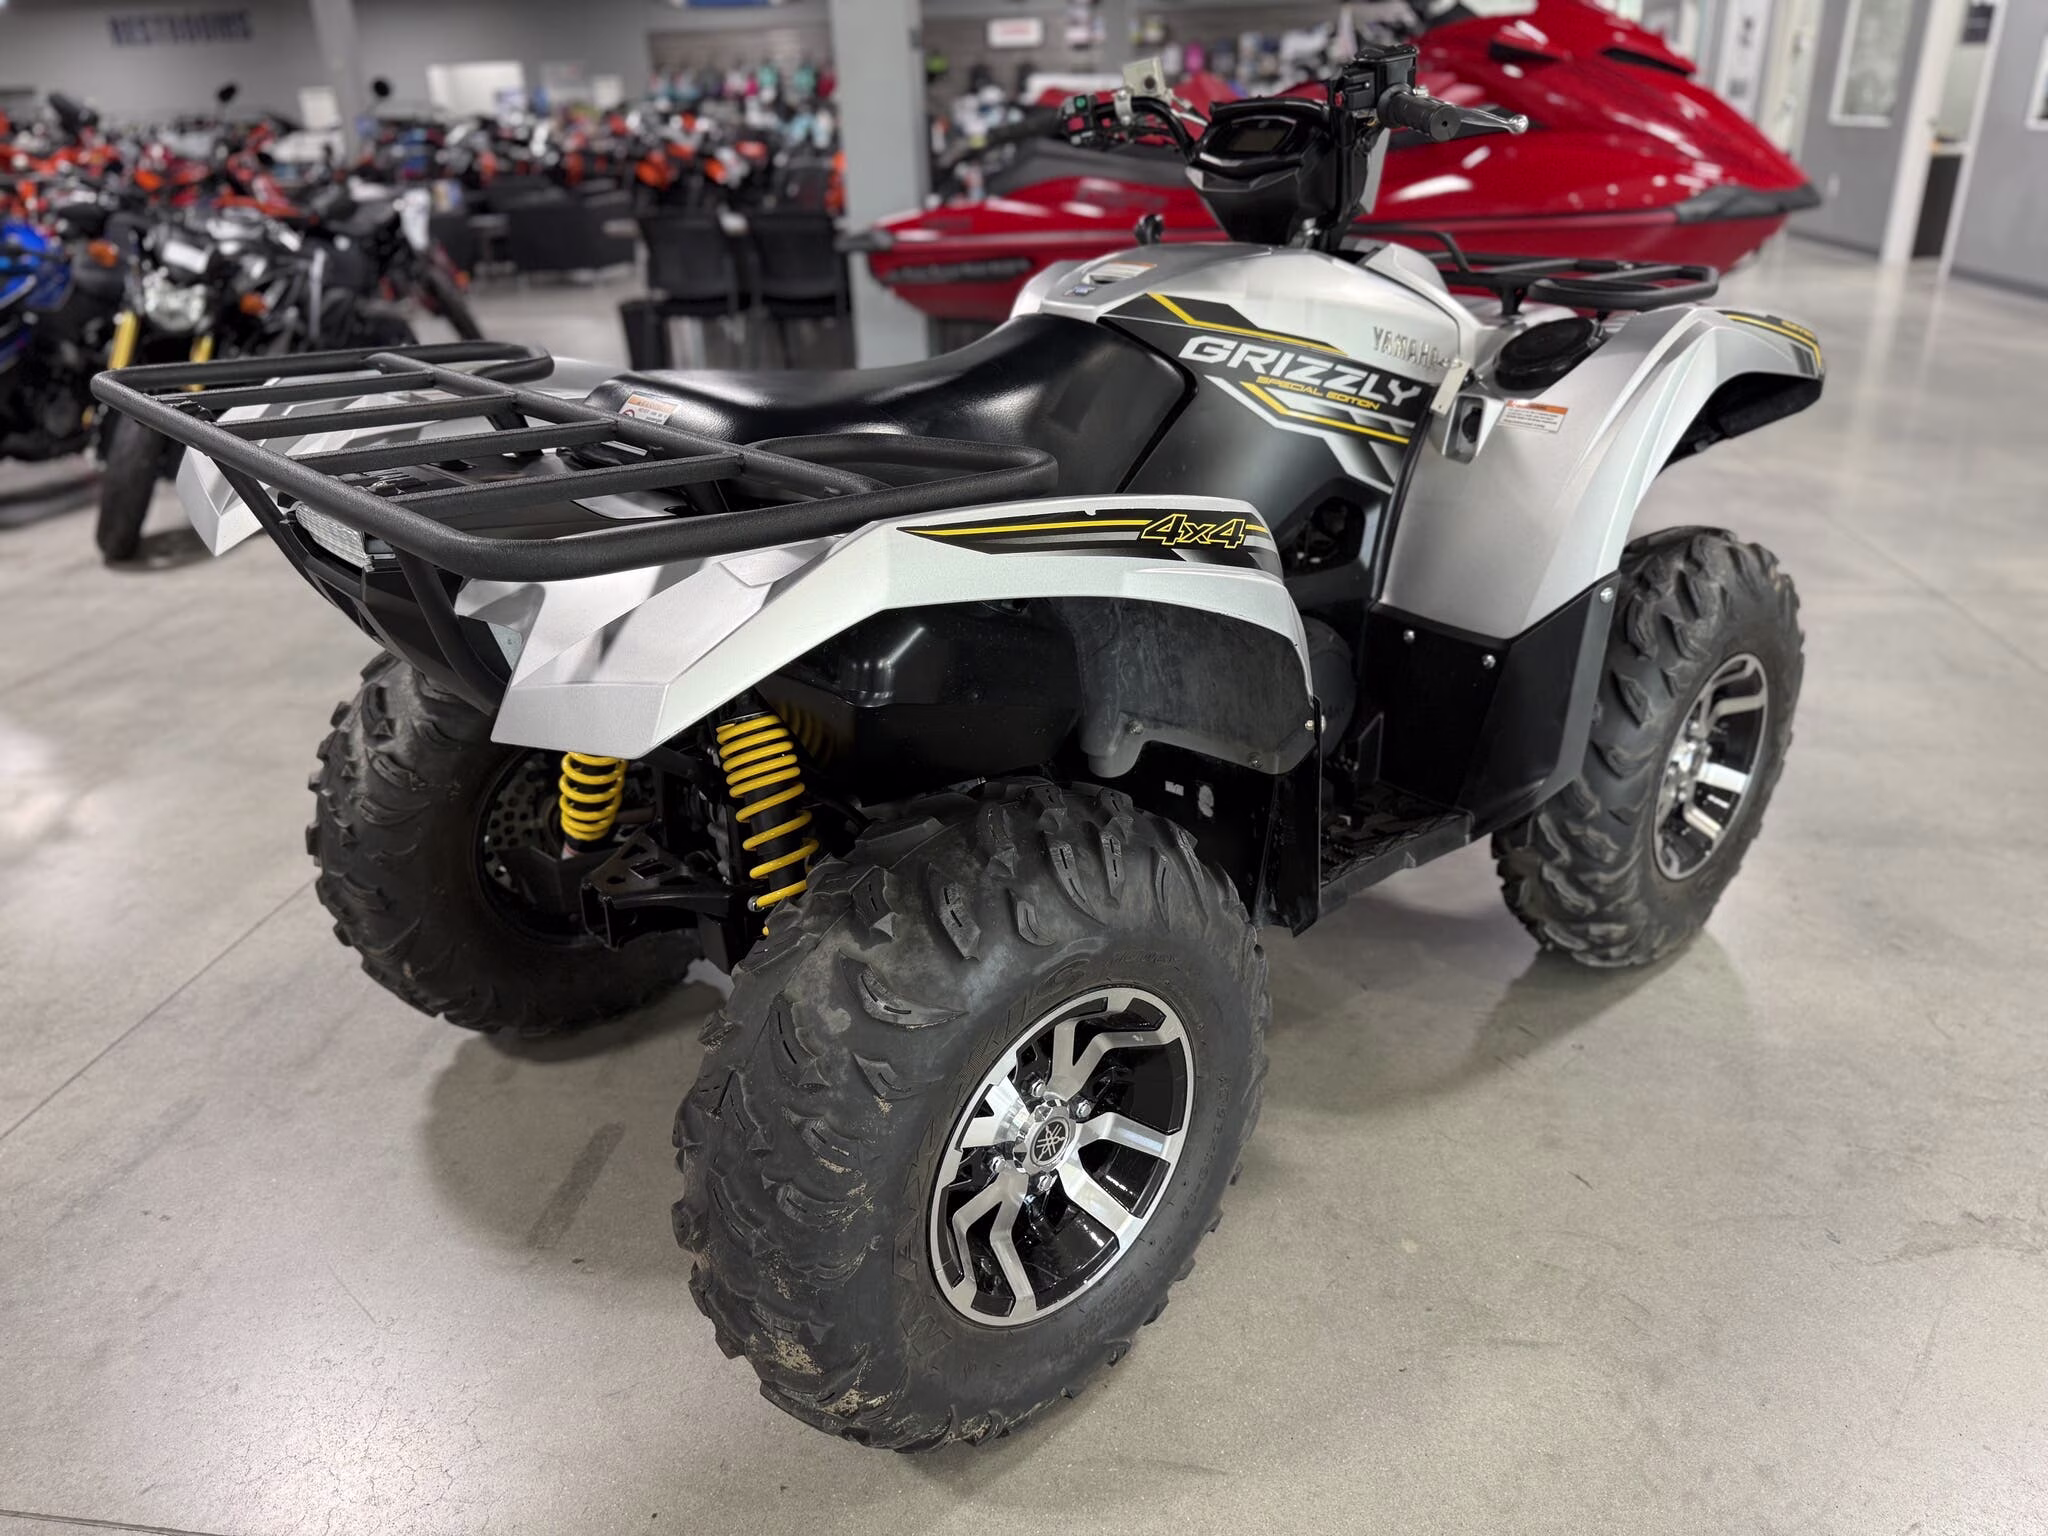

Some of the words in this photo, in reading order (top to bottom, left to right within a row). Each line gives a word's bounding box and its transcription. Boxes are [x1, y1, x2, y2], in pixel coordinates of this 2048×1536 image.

[1178, 335, 1421, 407] GRIZZLY
[1256, 375, 1324, 397] SPECIAL
[1326, 390, 1380, 411] EDITION
[1141, 513, 1246, 549] 4x4
